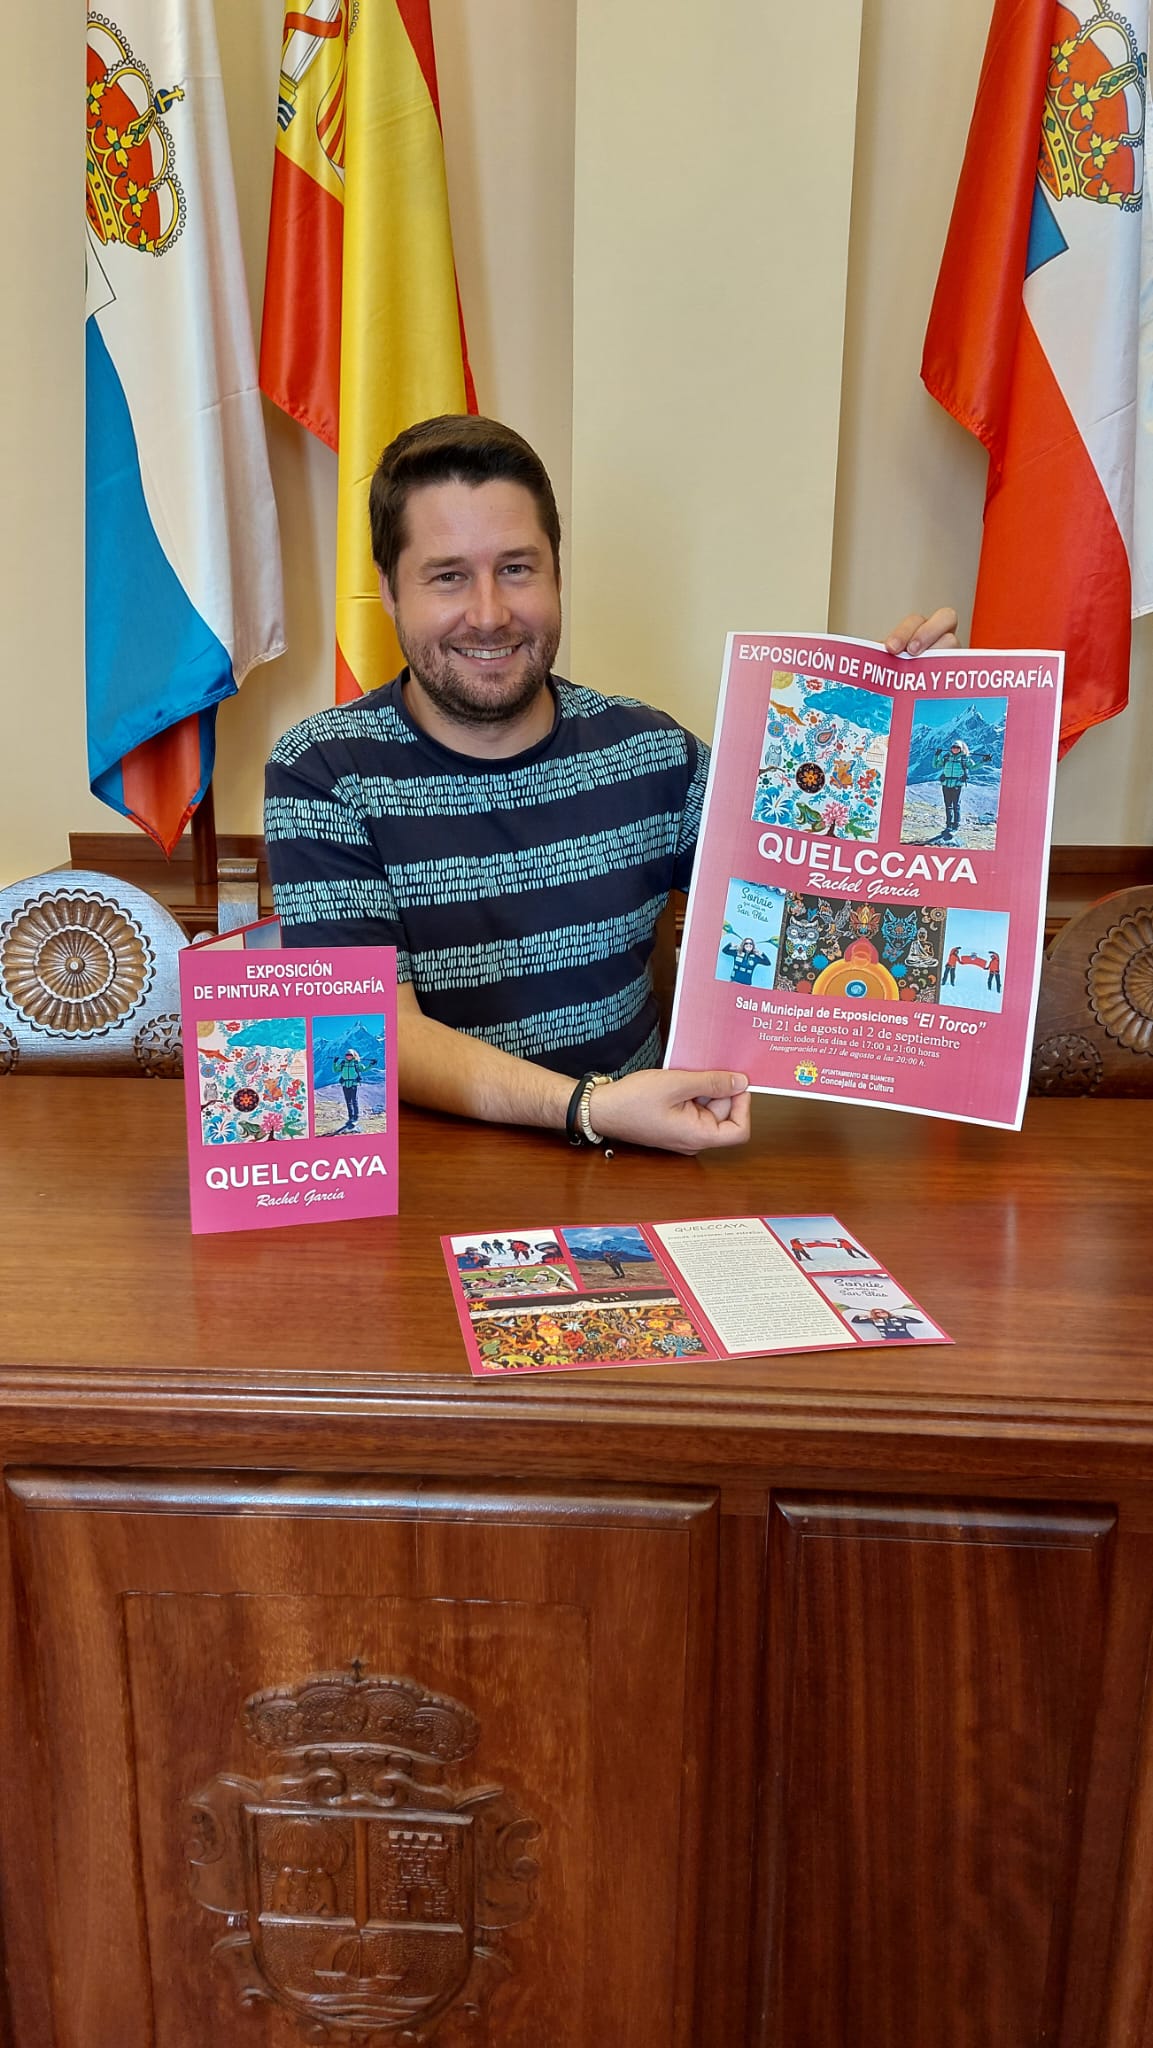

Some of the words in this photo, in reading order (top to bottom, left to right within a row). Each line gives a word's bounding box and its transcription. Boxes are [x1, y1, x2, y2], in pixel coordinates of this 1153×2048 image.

[738, 644, 835, 672] EXPOSICIÓN
[838, 655, 861, 678] DE
[862, 662, 927, 691] PINTURA
[931, 671, 943, 690] Y
[945, 665, 1054, 690] FOTOGRAFÍA
[758, 832, 978, 885] QUELCCAYA
[806, 872, 861, 893] Rachel
[867, 879, 921, 899] García
[246, 960, 333, 979] EXPOSICIÓN
[193, 985, 214, 1000] DE
[217, 983, 280, 999] PINTURA
[281, 982, 293, 997] Y
[295, 976, 385, 996] FOTOGRAFÍA
[735, 996, 758, 1011] Sala
[761, 1000, 813, 1019] Municipal
[816, 1007, 830, 1018] de
[833, 1008, 909, 1025] Exposiciones
[752, 1016, 772, 1030] Del
[776, 1019, 789, 1032] 21
[793, 1021, 807, 1033] de
[811, 1025, 849, 1036] agosto
[852, 1026, 863, 1037] al
[867, 1027, 874, 1038] 2
[878, 1028, 892, 1039] de
[895, 1032, 960, 1049] septiembre
[759, 1032, 791, 1043] Horario:
[793, 1034, 815, 1043] todos
[817, 1036, 829, 1045] los
[849, 1039, 859, 1047] de
[862, 1041, 884, 1050] 17:00
[893, 1044, 917, 1055] 21:00
[918, 1048, 940, 1058] horas
[819, 1046, 827, 1054] el
[828, 1047, 837, 1055] 21
[839, 1048, 848, 1057] de
[849, 1050, 874, 1060] agosto
[883, 1053, 894, 1062] las
[821, 1068, 861, 1079] AYUNTAMIENTO
[858, 1081, 867, 1090] de
[868, 1082, 894, 1093] Cultura
[205, 1155, 387, 1190] QUELCCAYA
[256, 1191, 300, 1208] Rachel
[304, 1187, 345, 1206] García
[674, 1223, 748, 1233] QUELCCAYA
